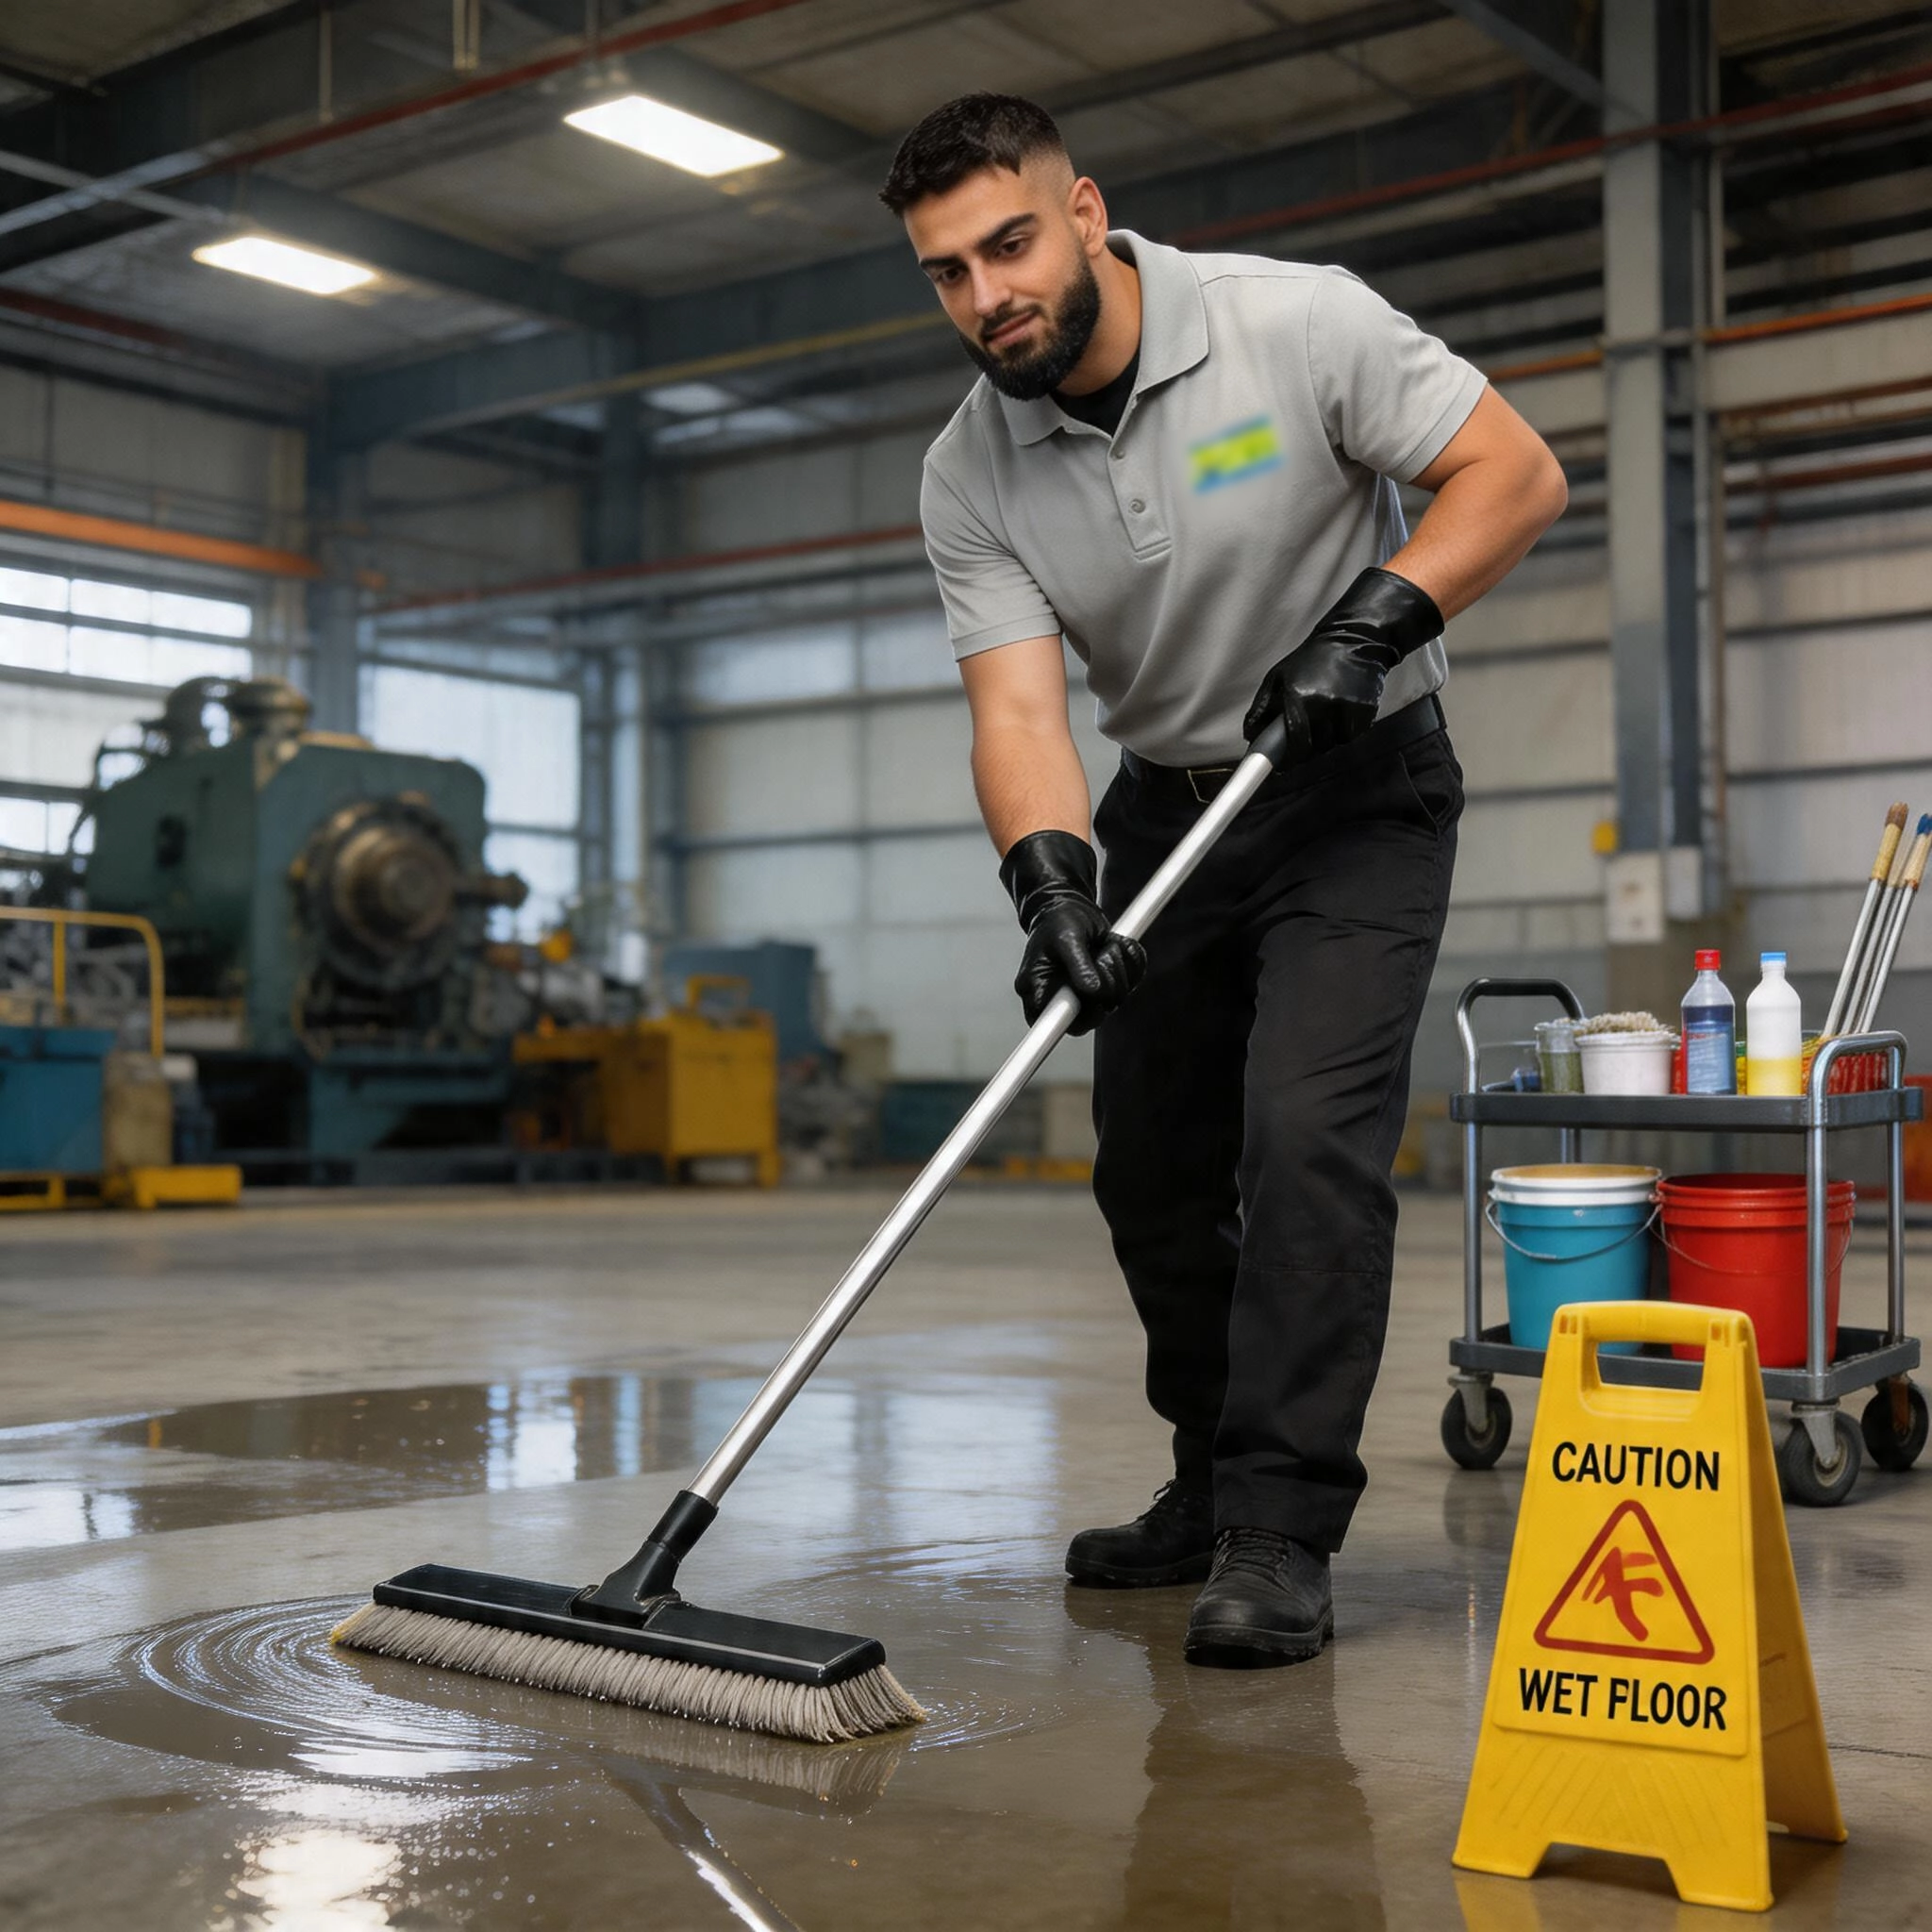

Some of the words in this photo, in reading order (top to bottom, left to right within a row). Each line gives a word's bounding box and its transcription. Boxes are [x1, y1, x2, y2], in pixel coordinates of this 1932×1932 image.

[1552, 1441, 1720, 1491] CAUTION
[1519, 1667, 1599, 1717] WET
[1607, 1677, 1727, 1731] FLOOR
